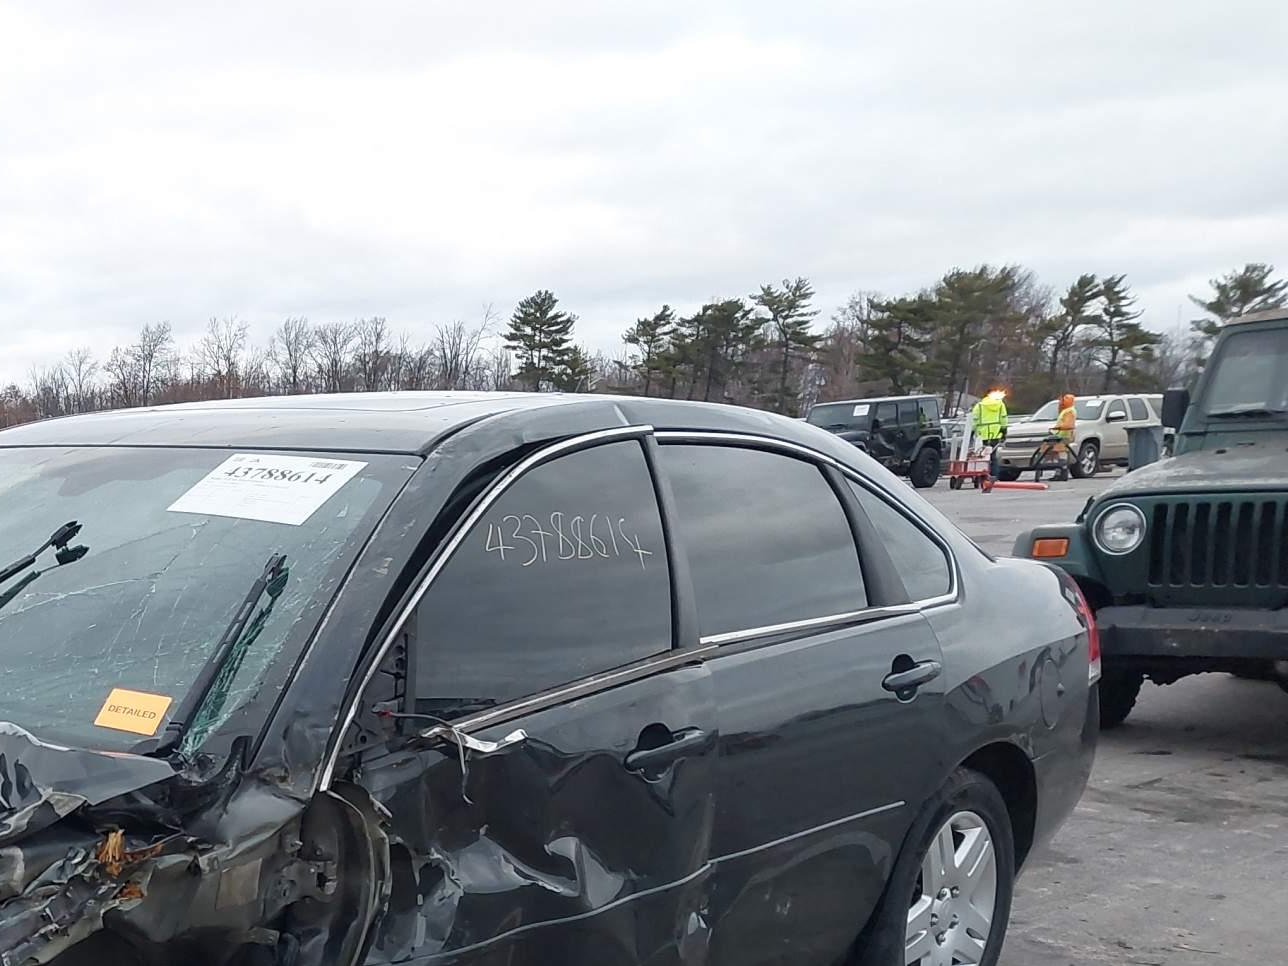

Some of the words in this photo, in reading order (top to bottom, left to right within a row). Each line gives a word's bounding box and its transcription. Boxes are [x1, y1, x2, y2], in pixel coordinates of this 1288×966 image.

[224, 466, 333, 485] 43788614
[485, 511, 653, 570] 43788614
[107, 704, 157, 720] DETAILED
